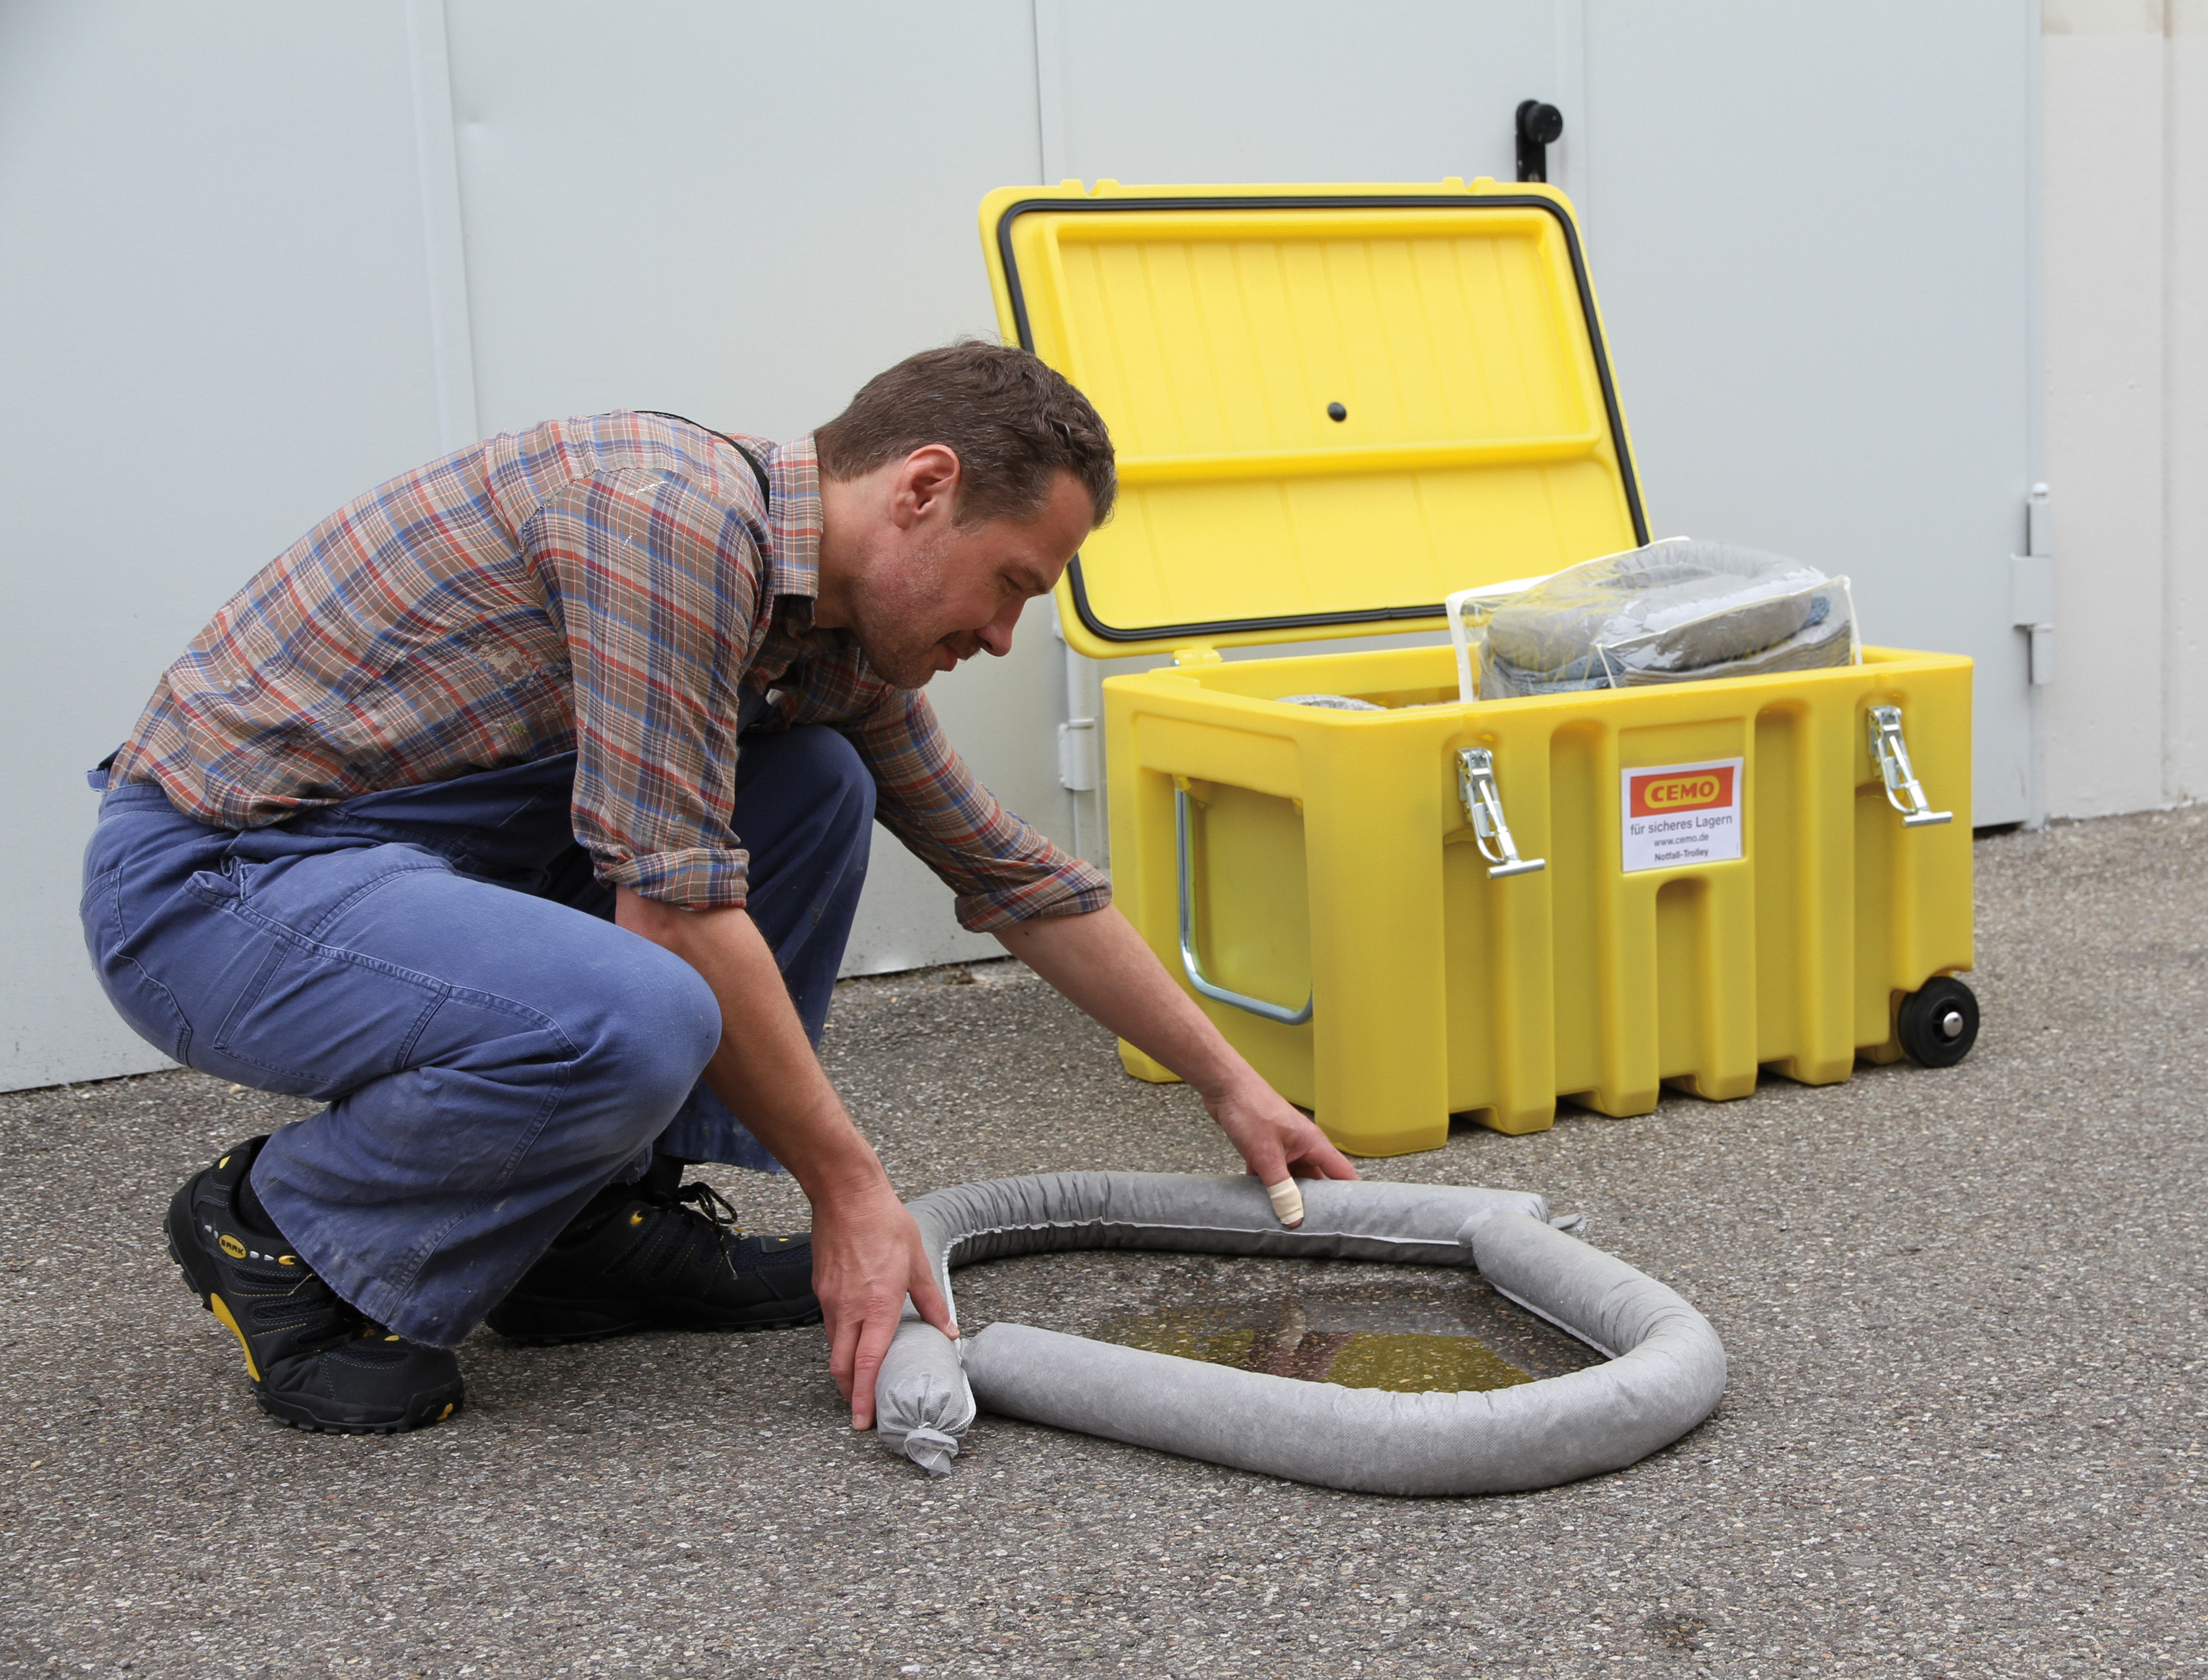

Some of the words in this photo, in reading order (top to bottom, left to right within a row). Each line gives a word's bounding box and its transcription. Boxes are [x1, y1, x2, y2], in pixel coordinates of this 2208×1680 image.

[1651, 780, 1715, 803] CEMO
[1630, 824, 1645, 836] für
[1648, 820, 1692, 834] sicheres
[1695, 815, 1733, 829] Lagern
[1654, 833, 1709, 846] www.cemo.de
[1655, 848, 1709, 861] Notfall-Trolley
